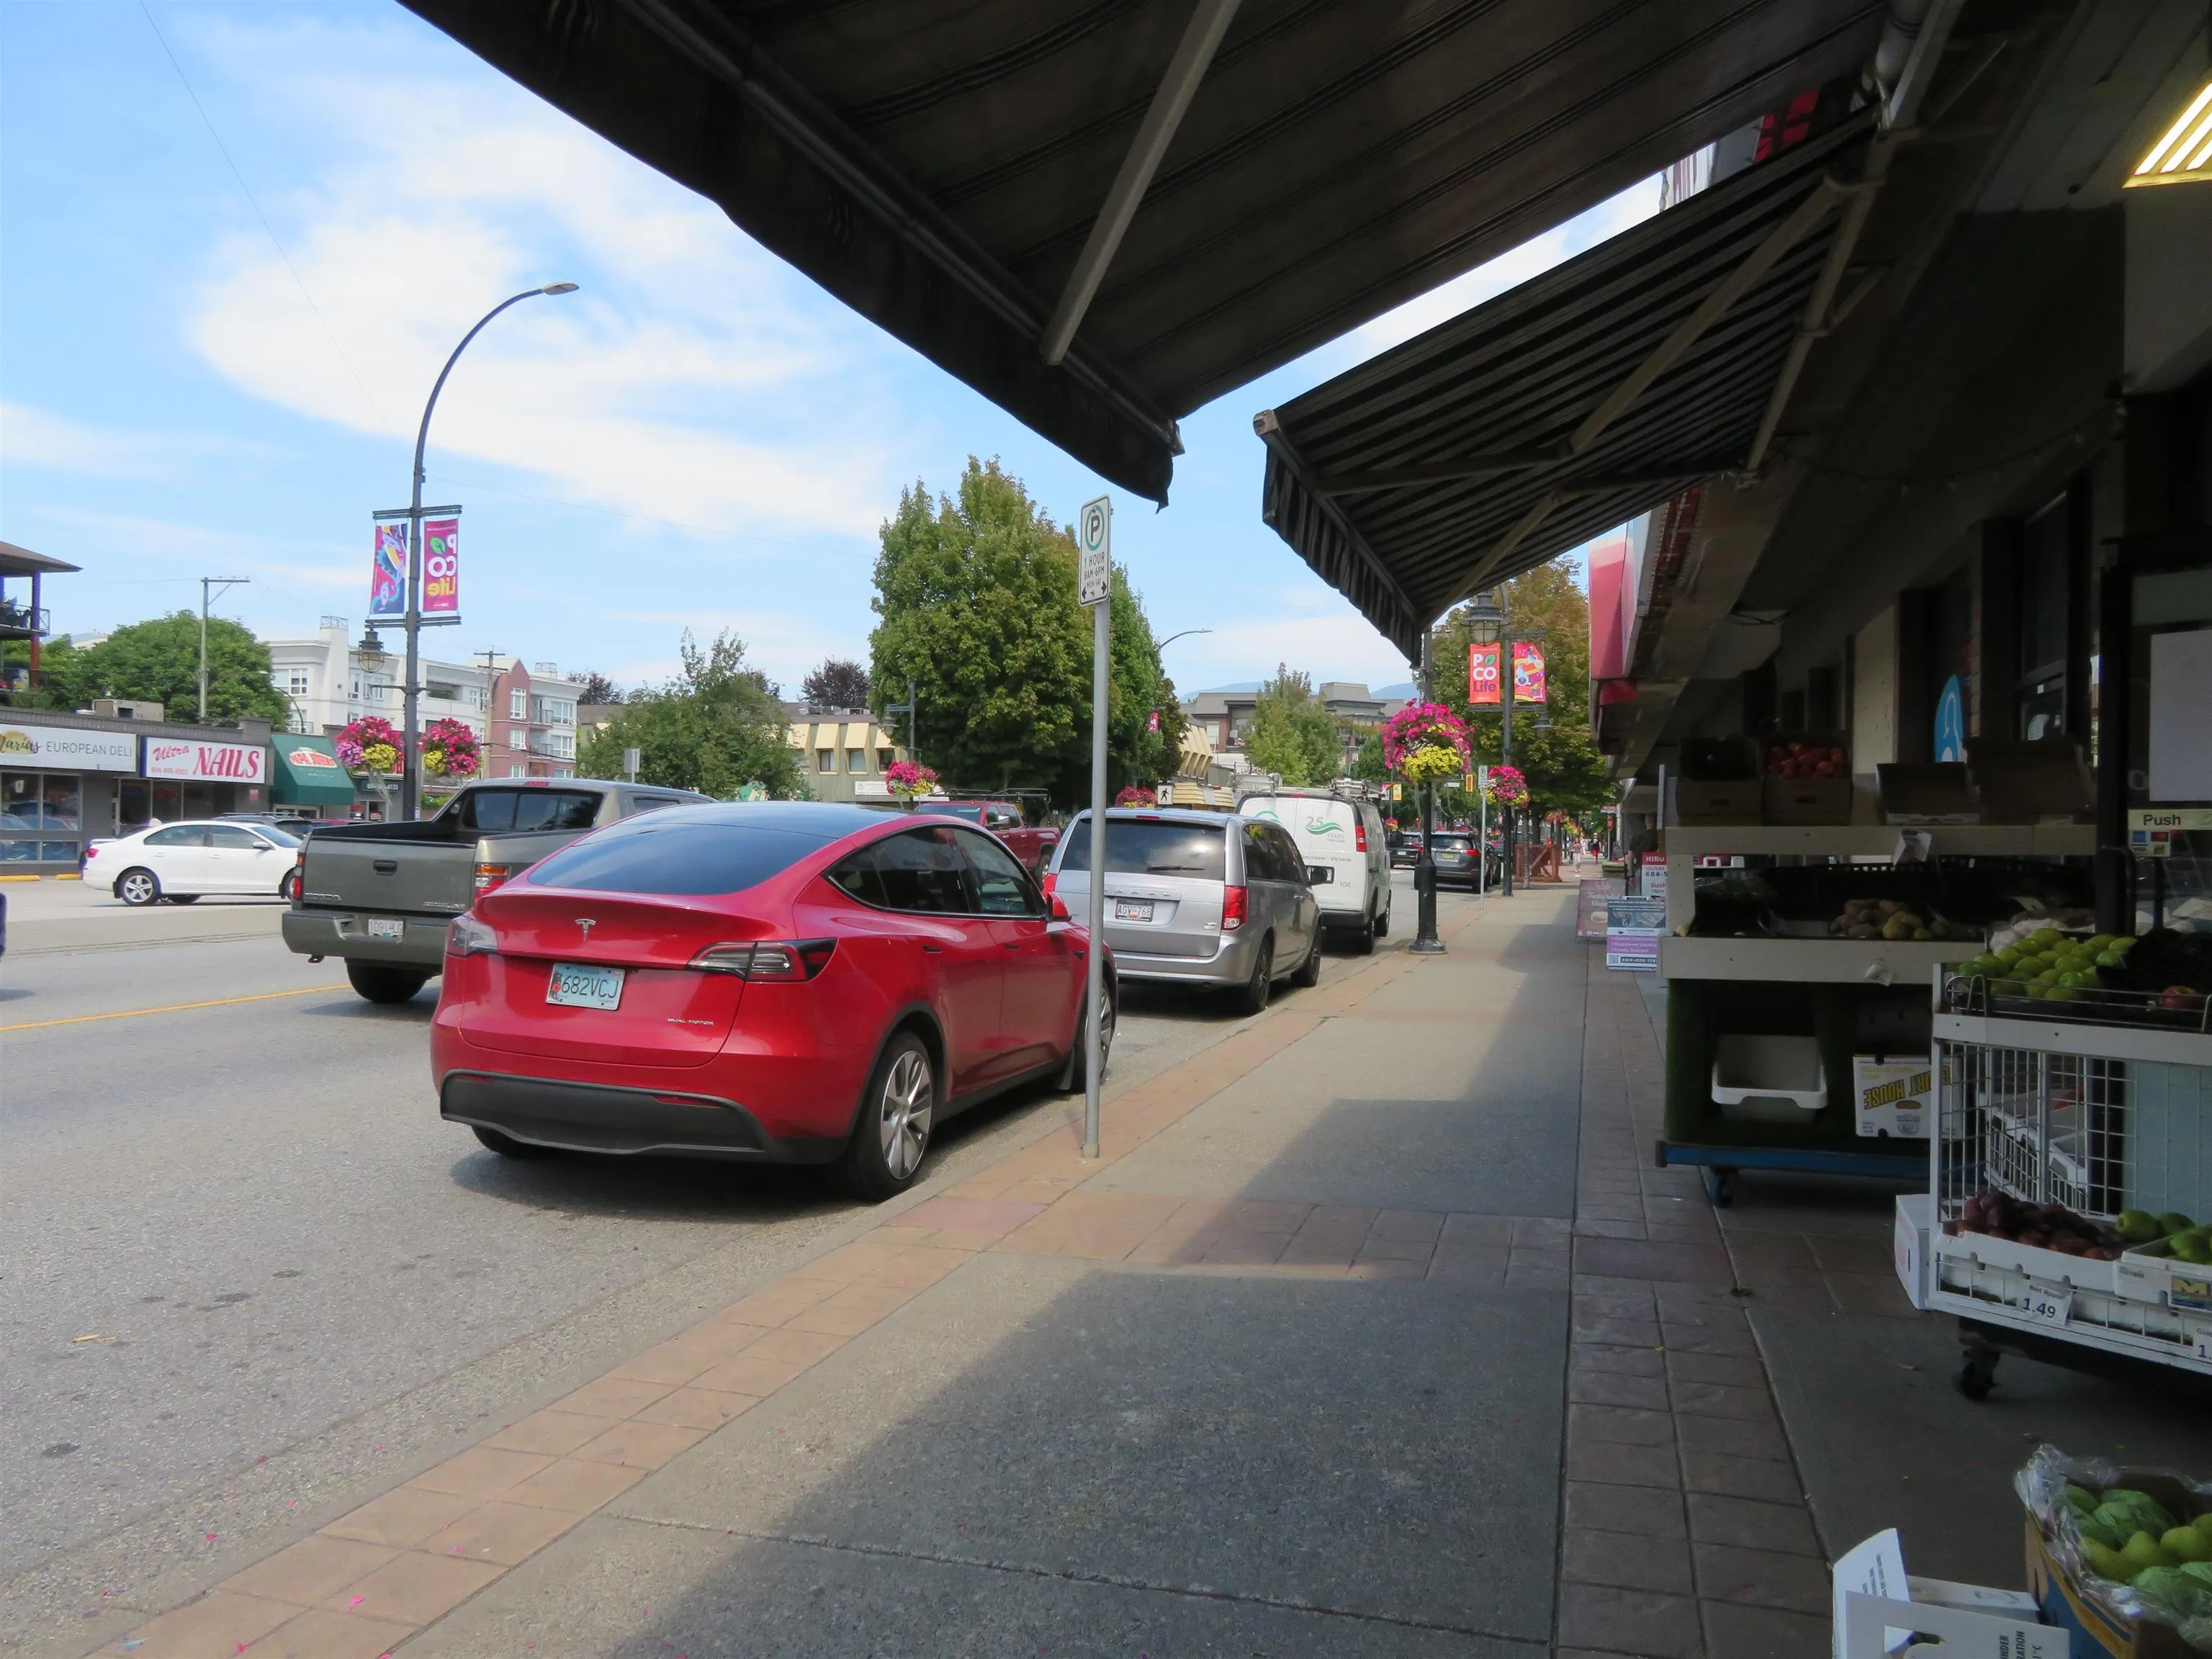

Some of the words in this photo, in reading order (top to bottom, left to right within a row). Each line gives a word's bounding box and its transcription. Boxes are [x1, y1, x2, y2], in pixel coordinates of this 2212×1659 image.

[1090, 515, 1100, 542] P
[1089, 552, 1105, 567] HOUR
[1473, 680, 1496, 692] Life
[46, 741, 107, 755] EUROPEAN
[109, 745, 132, 757] DELI
[153, 745, 190, 761] Ultra
[193, 747, 260, 779] NAILS
[1306, 816, 1323, 827] 25
[2143, 814, 2181, 826] Push
[562, 975, 619, 999] 682VCJ
[1910, 1066, 1951, 1097] CURT
[2023, 1298, 2056, 1318] 1.49
